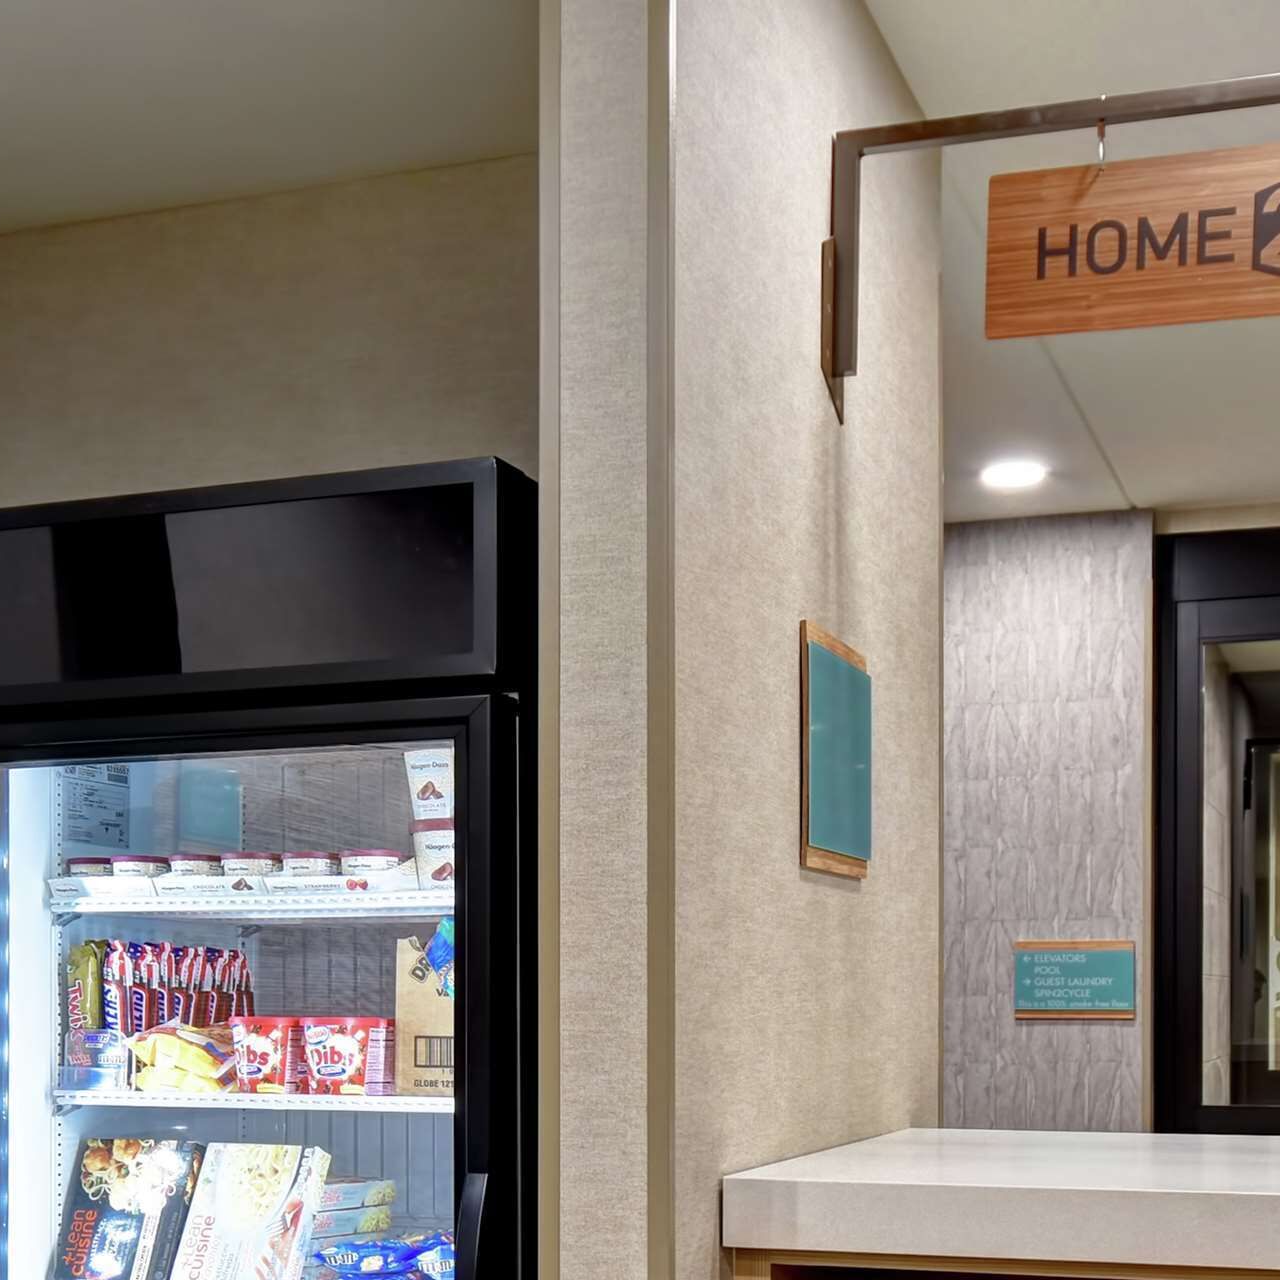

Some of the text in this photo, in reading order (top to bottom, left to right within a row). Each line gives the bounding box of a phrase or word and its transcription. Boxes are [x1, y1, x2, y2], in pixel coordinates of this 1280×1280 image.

[1036, 204, 1237, 281] HOME
[1034, 954, 1086, 963] ELEVATORS
[1034, 966, 1061, 974] POOL
[1034, 977, 1113, 985] GUEST LAUNDRY
